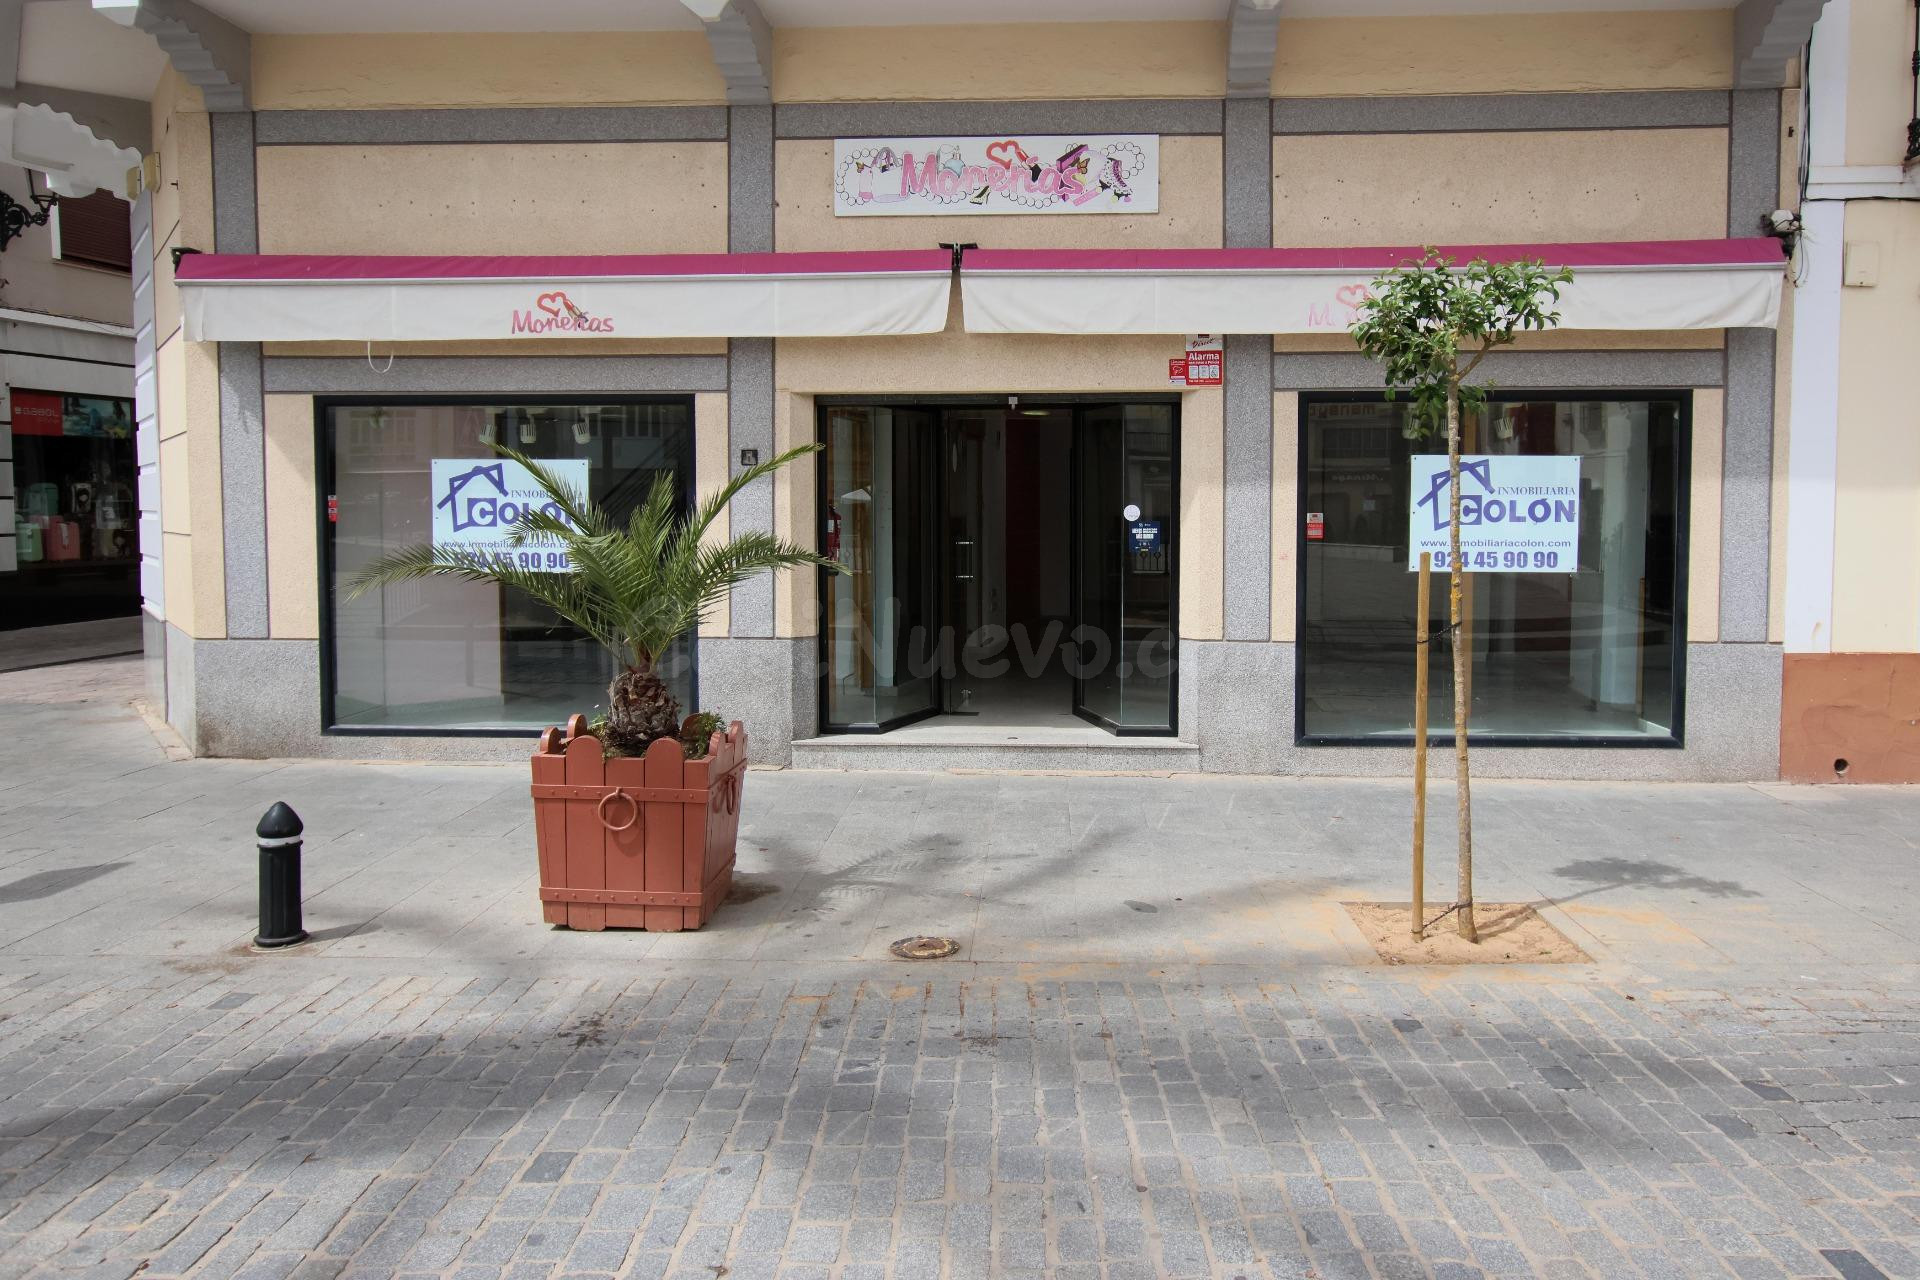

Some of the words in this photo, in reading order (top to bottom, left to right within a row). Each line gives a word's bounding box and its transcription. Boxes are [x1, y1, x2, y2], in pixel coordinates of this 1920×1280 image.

[1188, 352, 1220, 361] Alarma
[1497, 486, 1576, 496] INMOBILIARIA
[1420, 539, 1571, 548] www.mobiliariacolon.com
[519, 552, 541, 569] 90
[547, 552, 570, 569] 90
[1474, 551, 1498, 568] 45
[1503, 551, 1528, 568] 90
[1533, 551, 1558, 568] 90
